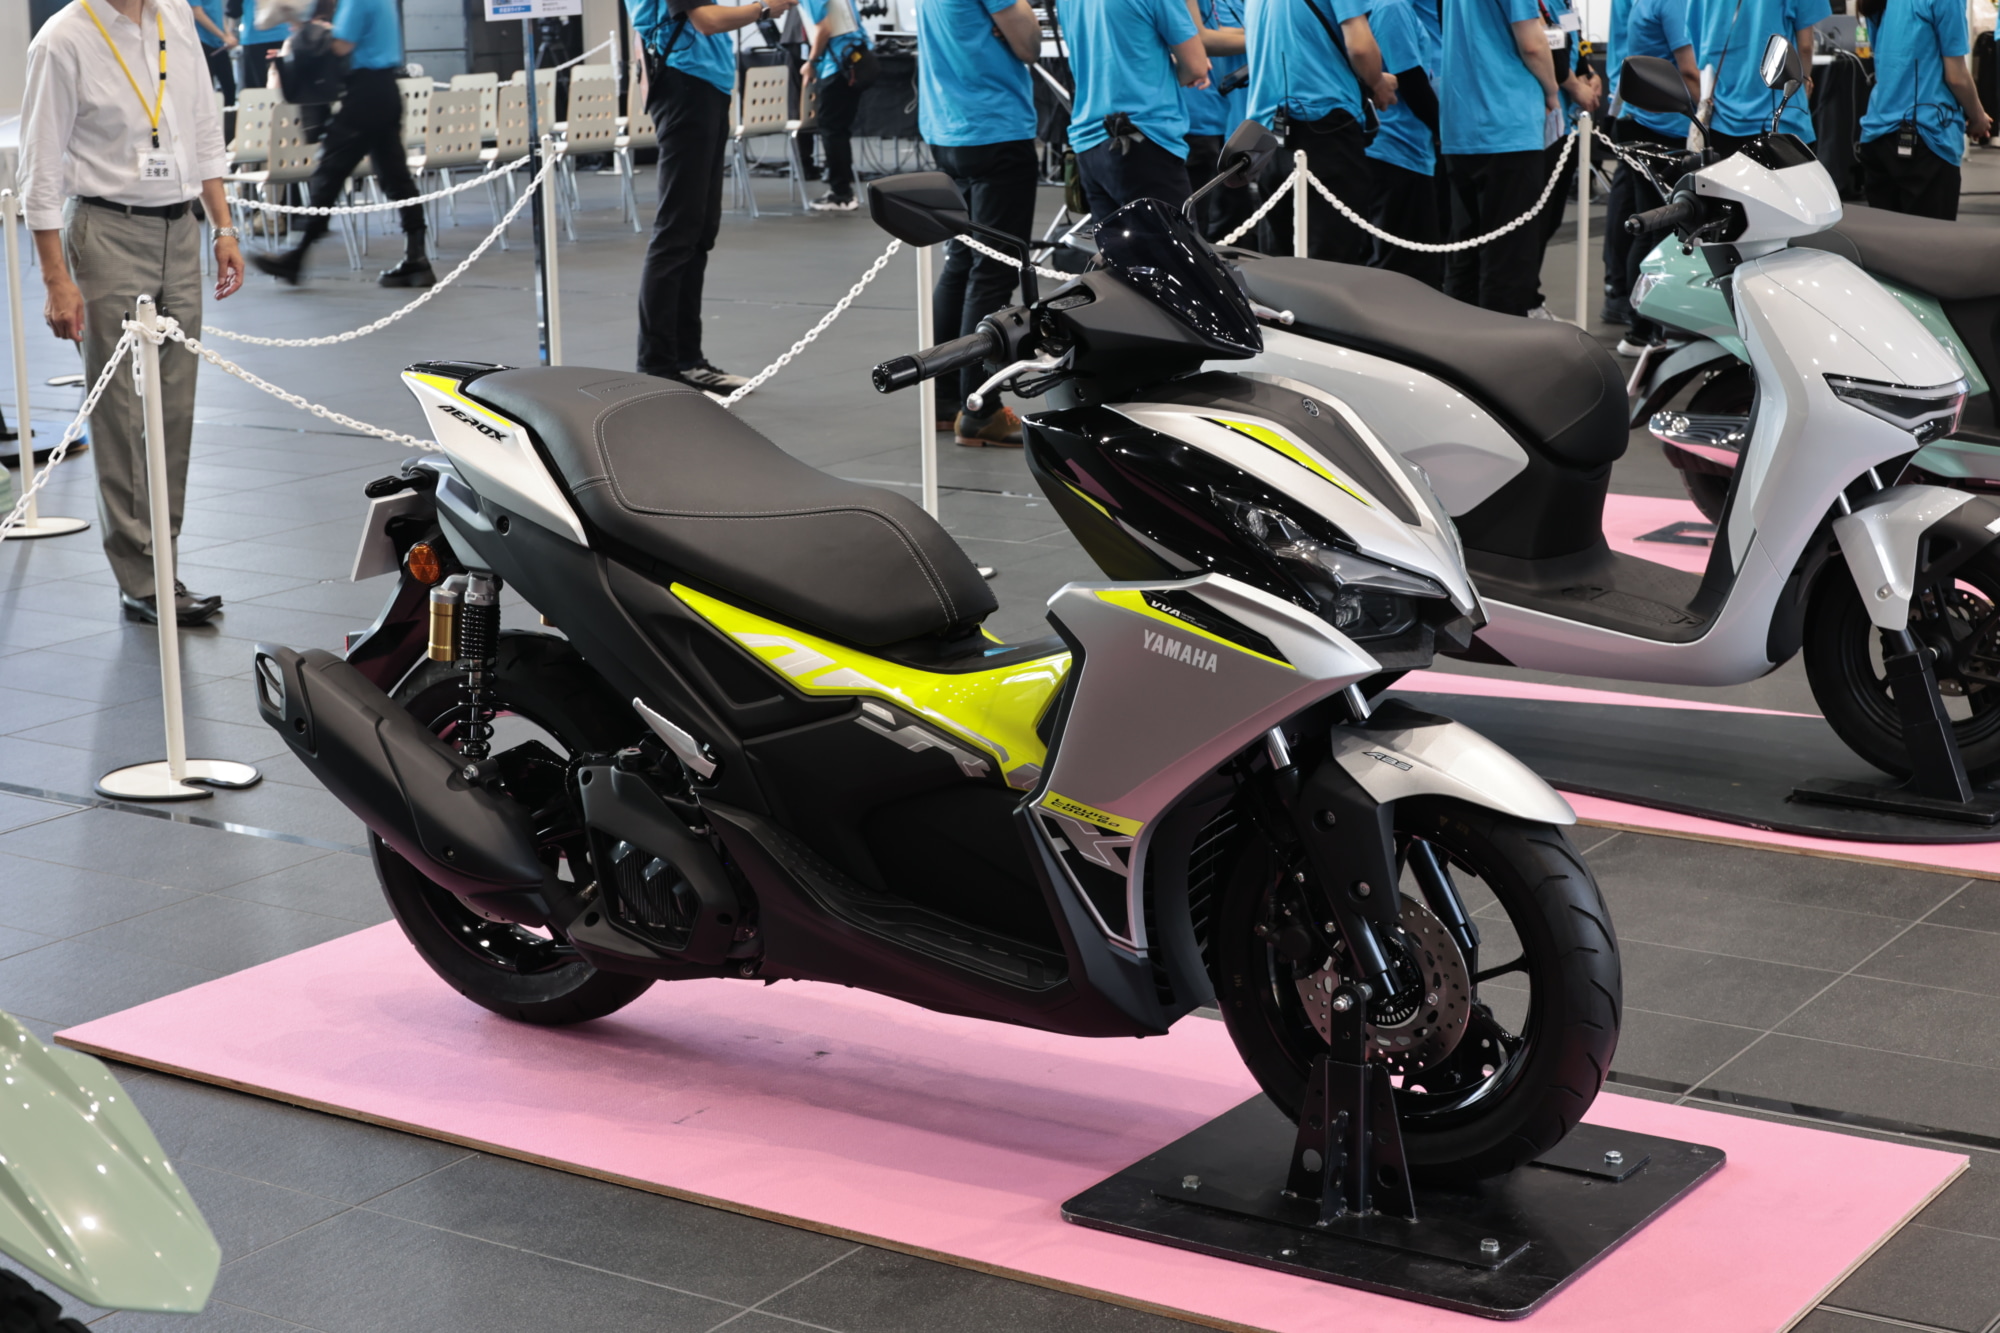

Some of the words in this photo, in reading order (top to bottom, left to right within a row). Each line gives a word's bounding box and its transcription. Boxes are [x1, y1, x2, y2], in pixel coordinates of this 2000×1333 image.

[145, 168, 169, 177] 主催者
[437, 405, 509, 443] AEROX
[1151, 600, 1181, 618] VVA
[1143, 629, 1218, 673] YAMAHA
[1362, 751, 1413, 771] ABS
[1051, 801, 1120, 827] COOLED
[1055, 798, 1111, 820] LIQUID
